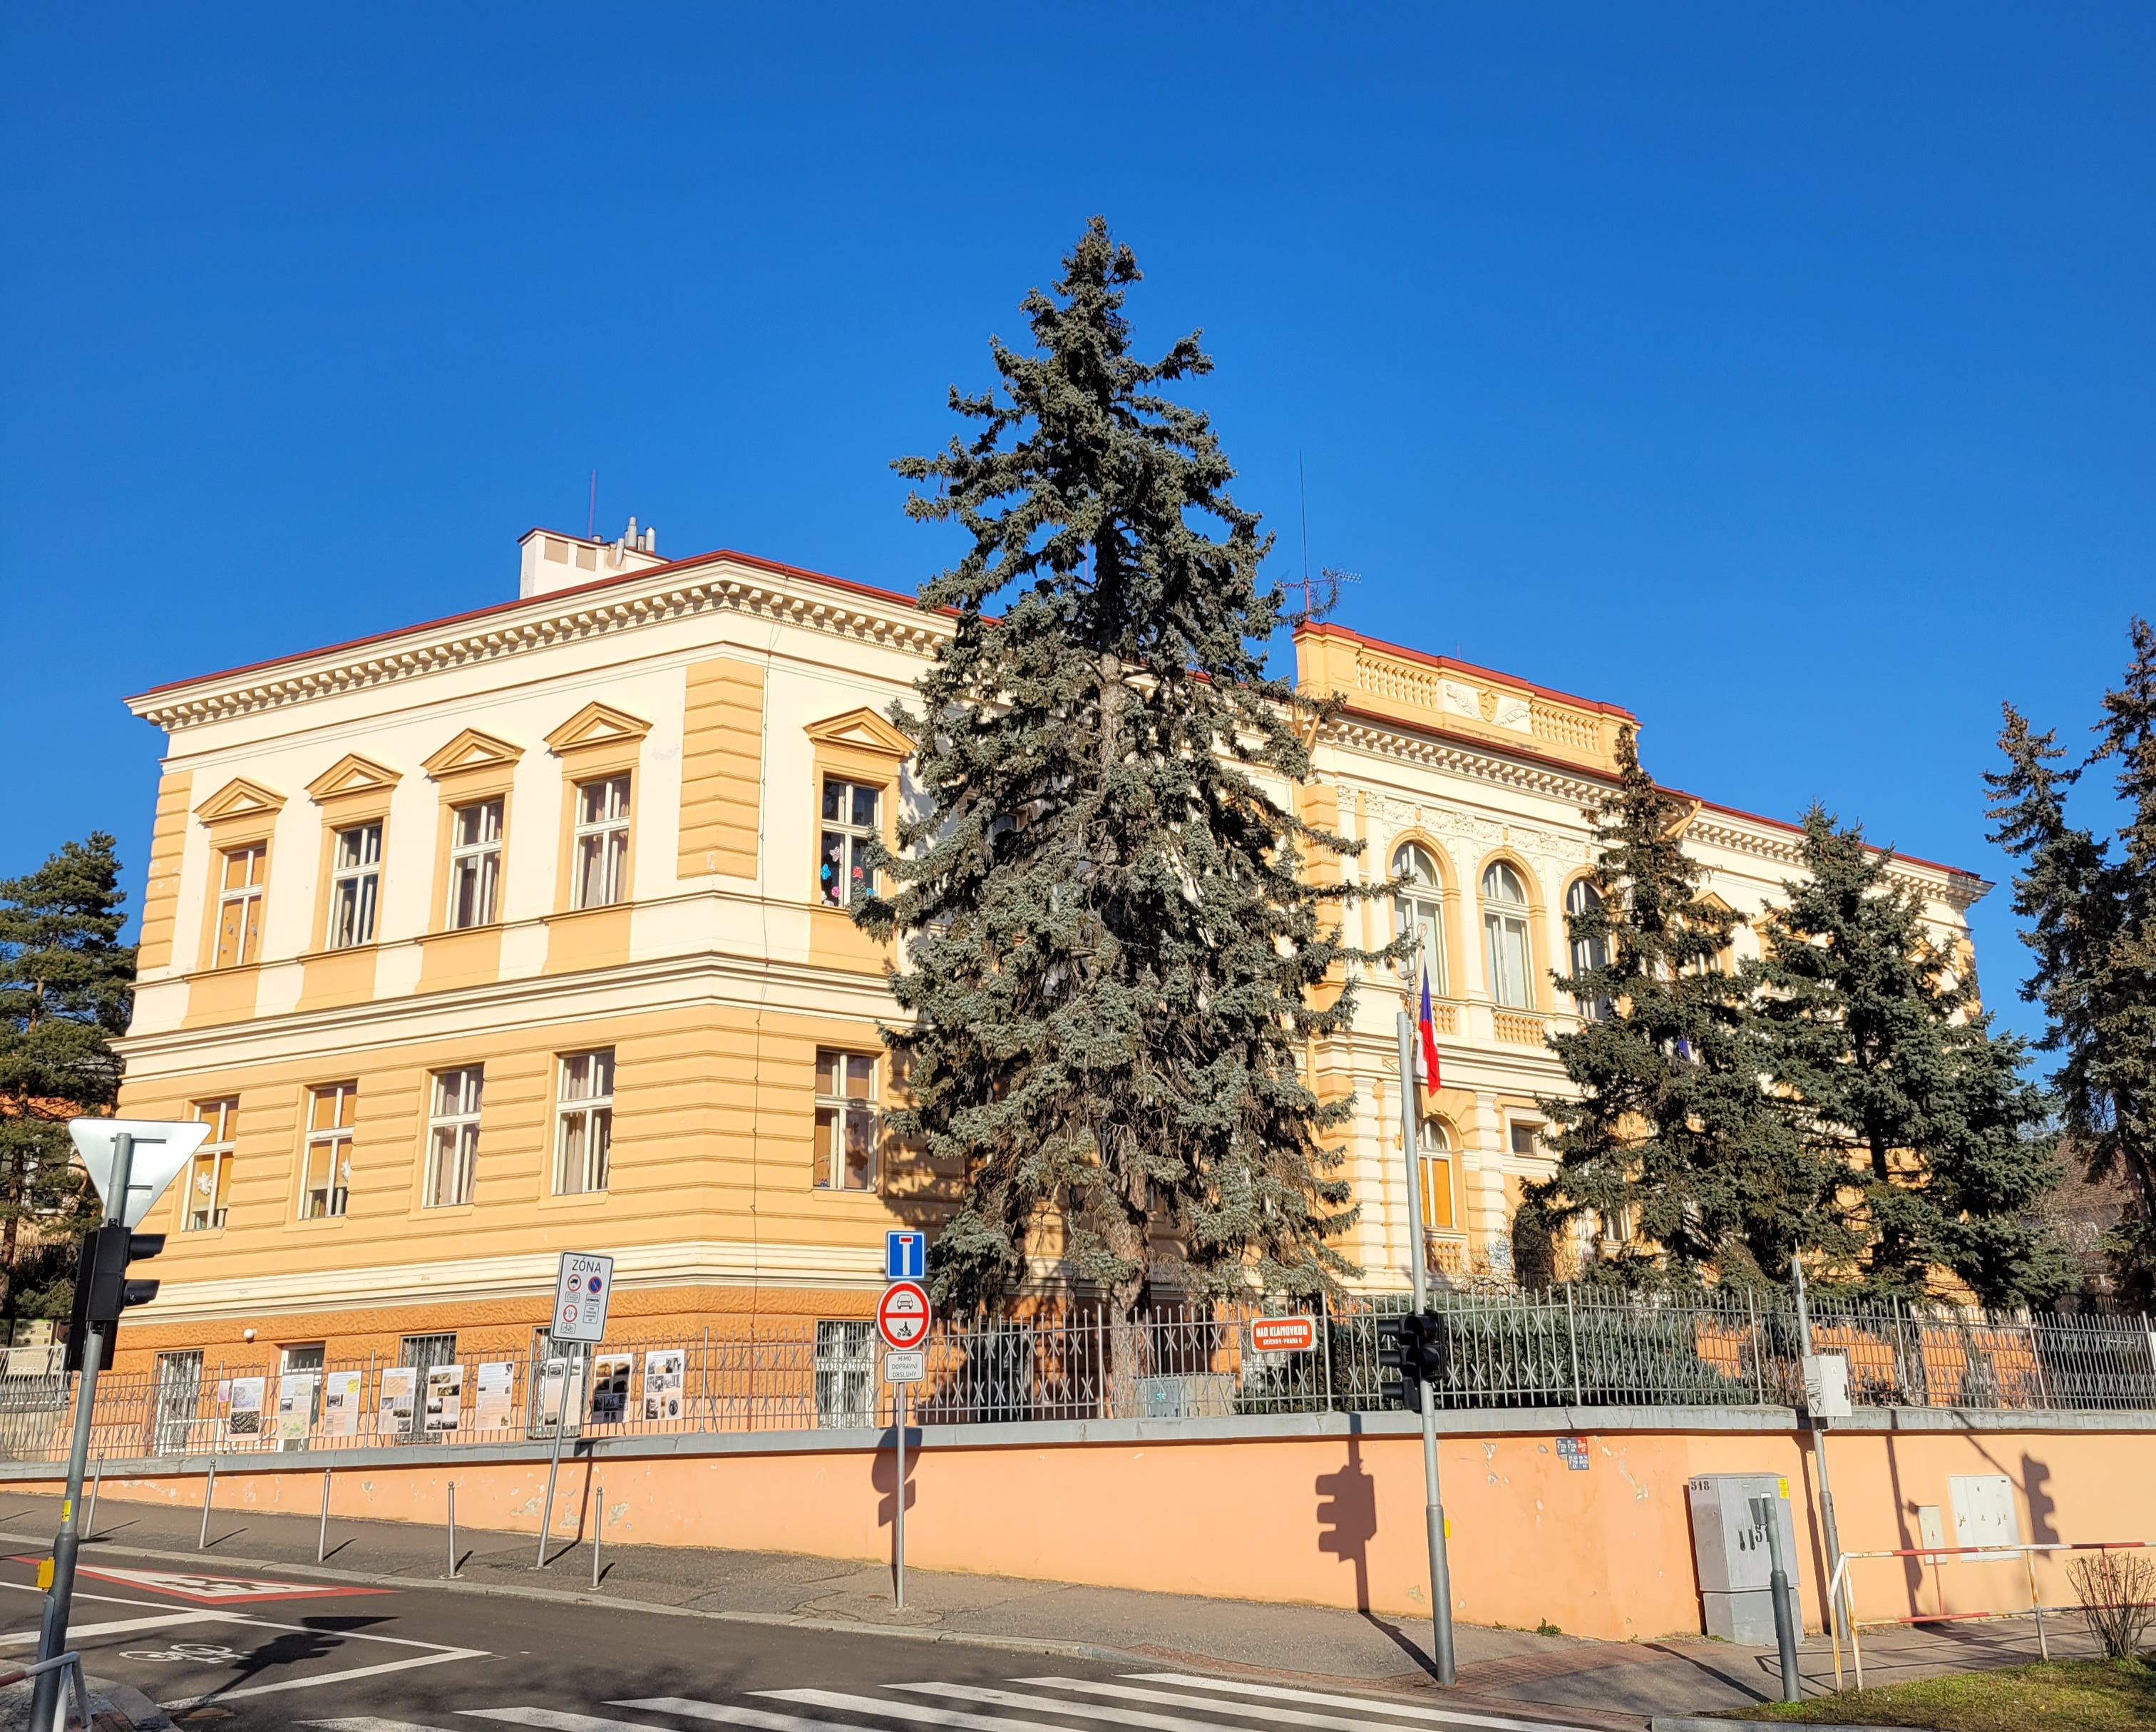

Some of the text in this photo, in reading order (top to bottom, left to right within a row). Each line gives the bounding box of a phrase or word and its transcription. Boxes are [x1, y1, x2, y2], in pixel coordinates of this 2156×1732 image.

[572, 1257, 601, 1274] ZÓNA
[1256, 1325, 1308, 1338] NAD KLAMOVKOU
[1690, 1480, 1710, 1491] 518
